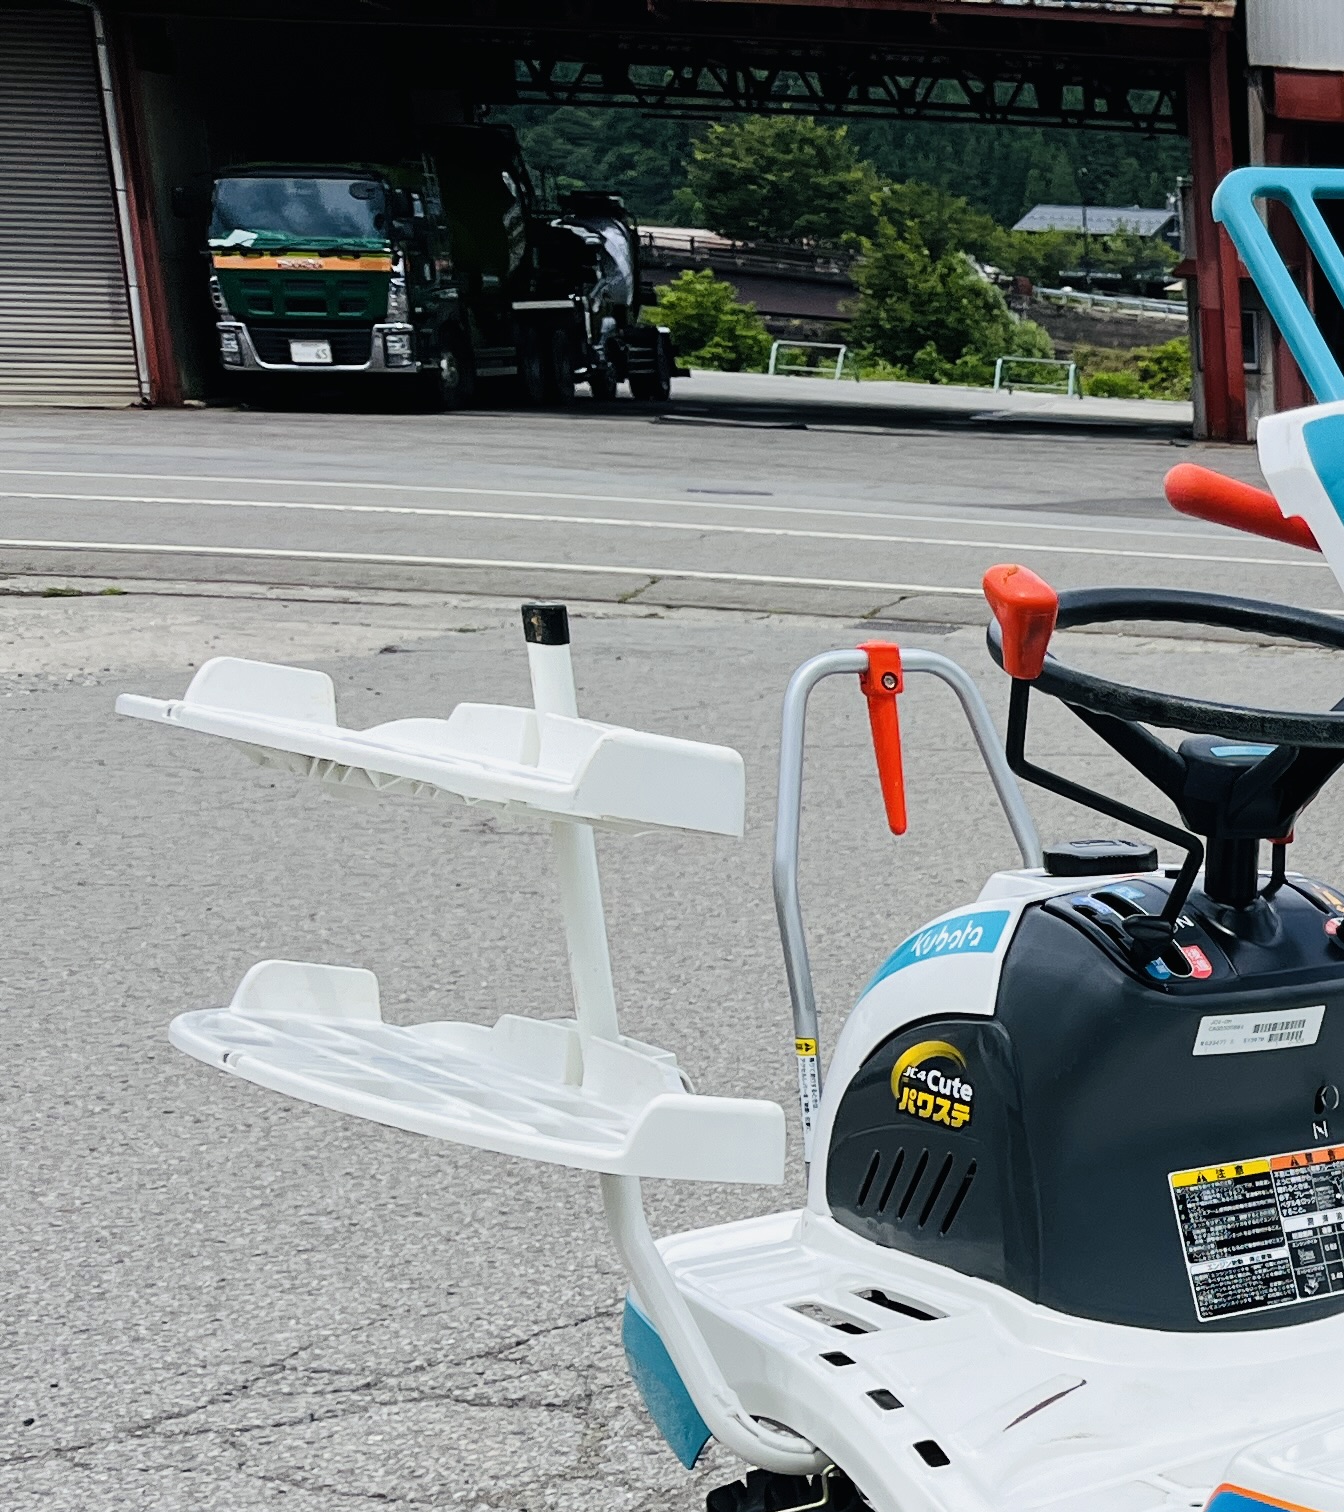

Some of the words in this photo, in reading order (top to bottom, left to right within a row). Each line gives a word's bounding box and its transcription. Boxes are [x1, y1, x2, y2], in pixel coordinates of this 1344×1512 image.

[911, 920, 984, 957] Kubota
[926, 1069, 973, 1102] Cute
[898, 1086, 971, 1128] パワステ
[1312, 1120, 1329, 1140] N
